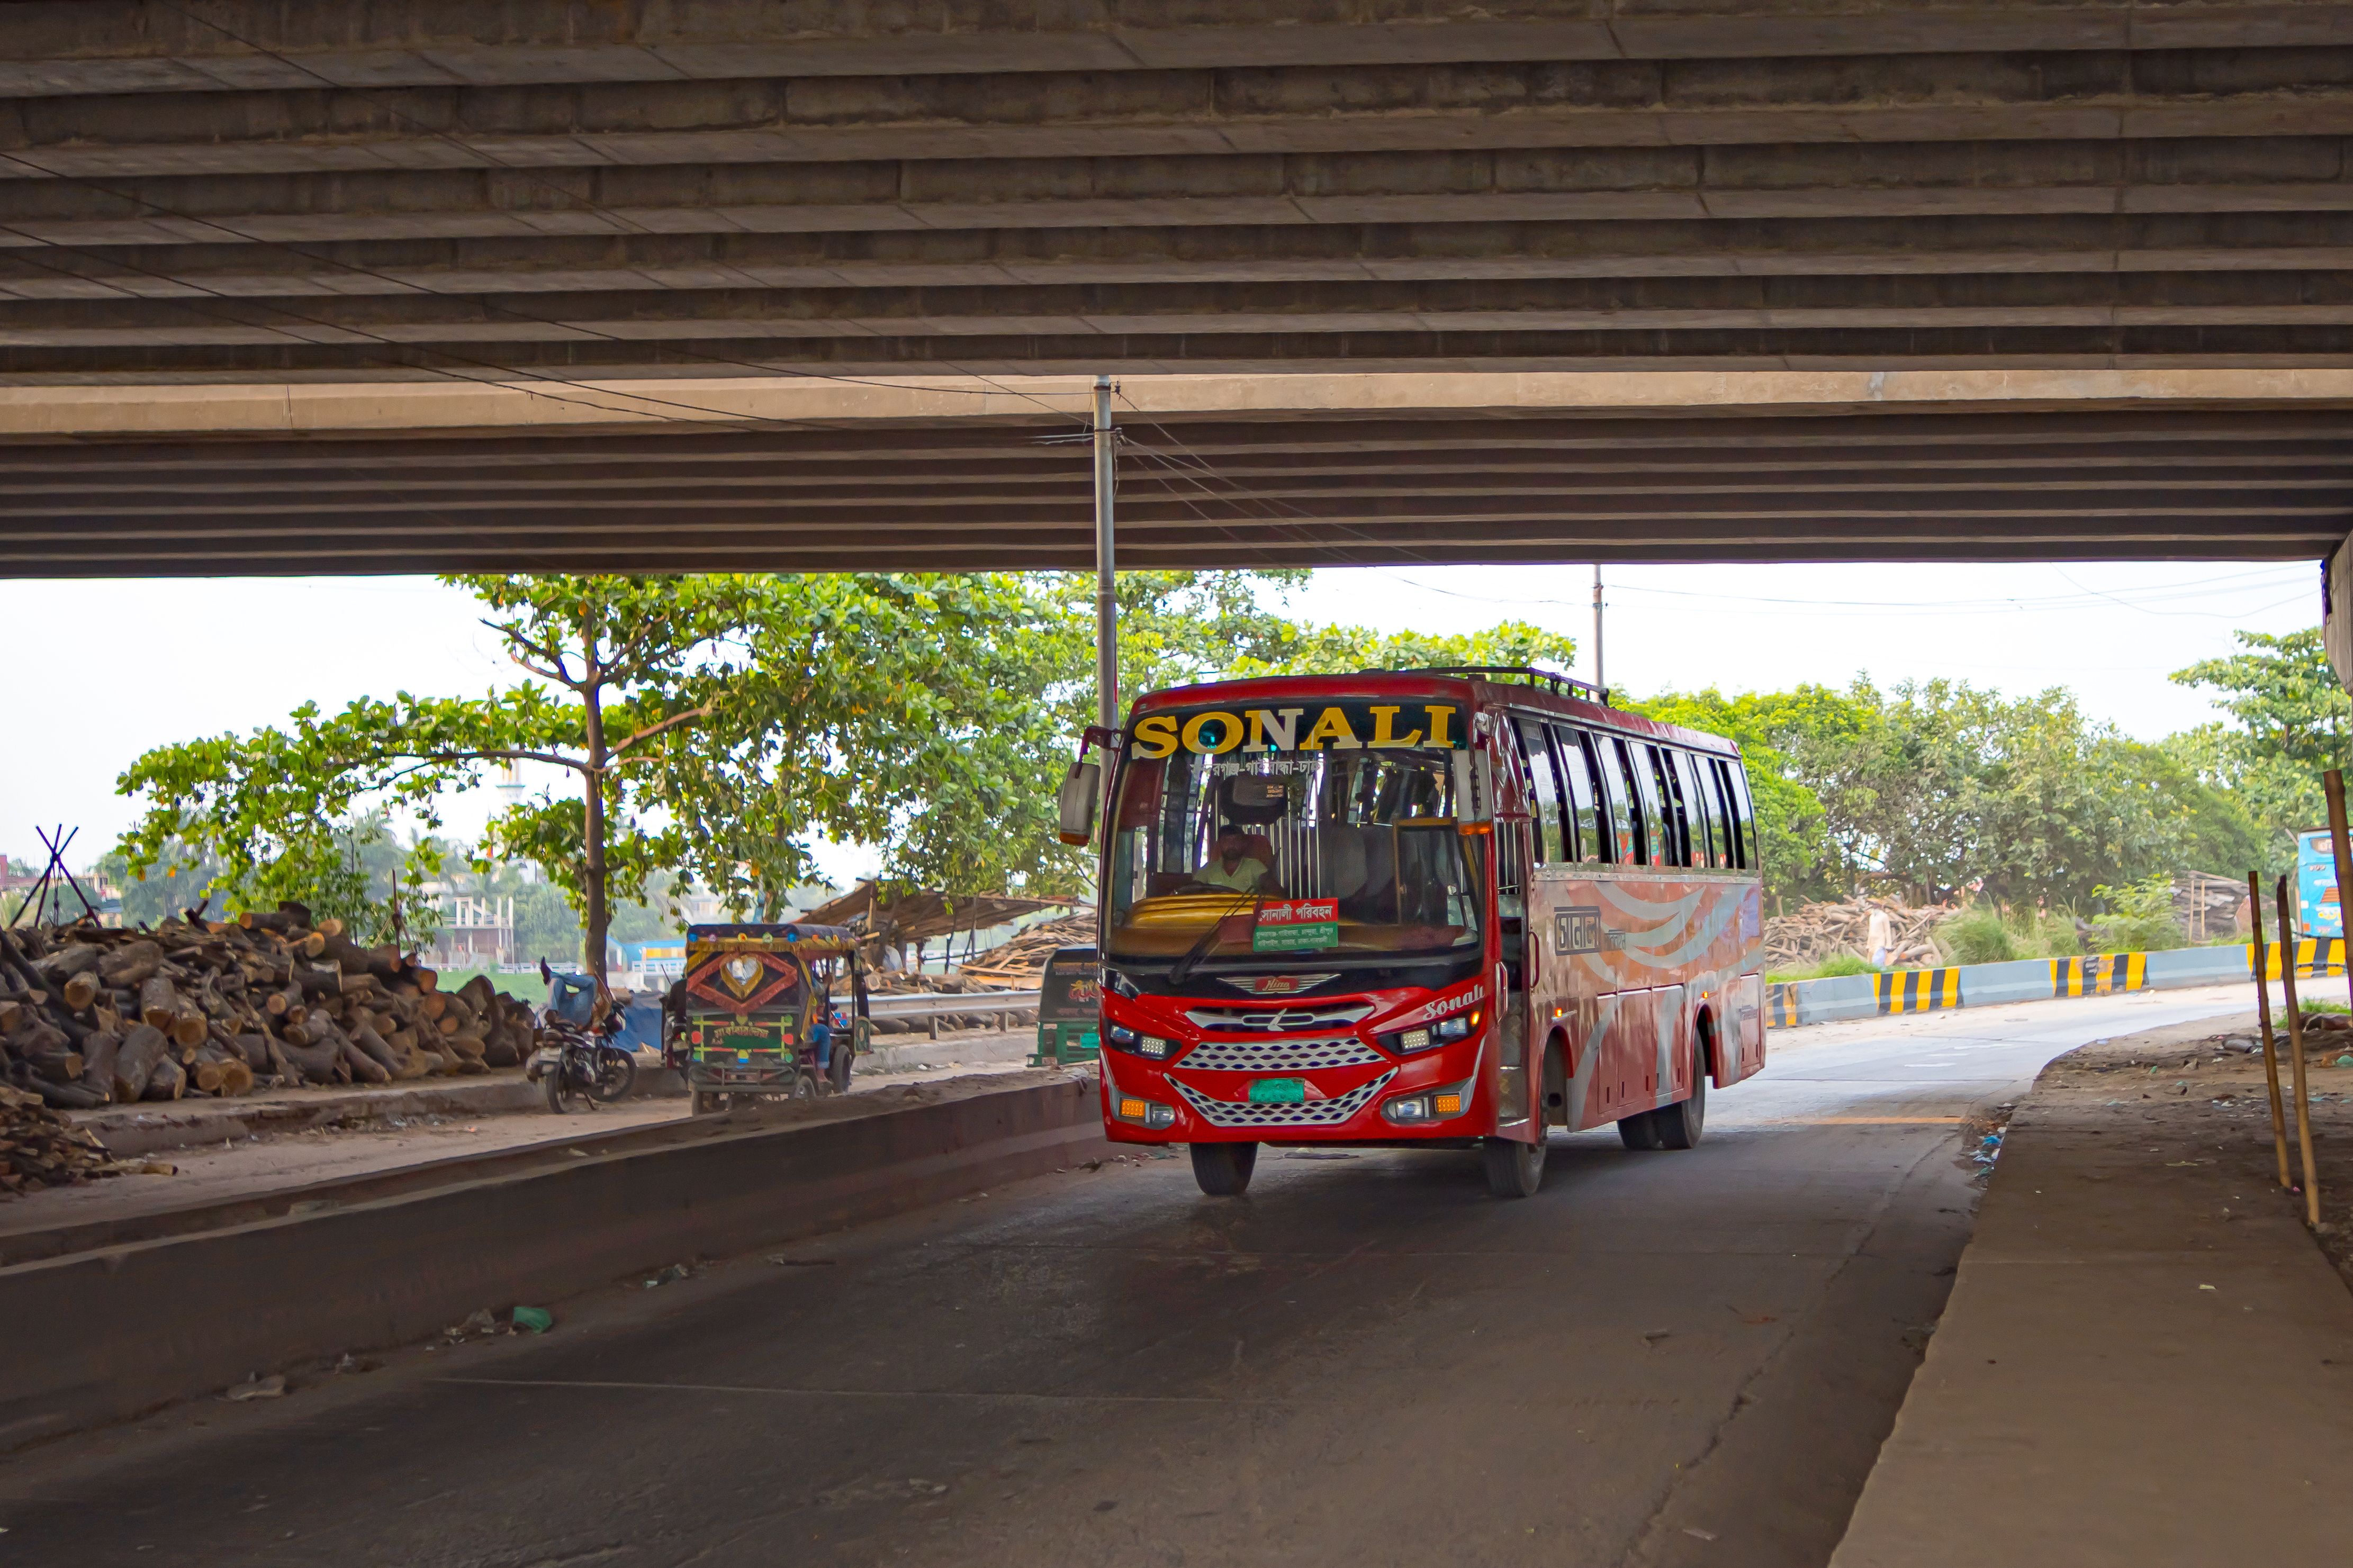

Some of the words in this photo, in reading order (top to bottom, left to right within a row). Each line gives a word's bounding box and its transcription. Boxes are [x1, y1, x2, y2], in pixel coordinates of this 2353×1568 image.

[1131, 705, 1456, 759] SONALI
[1296, 903, 1333, 919] পরিবহন
[1422, 984, 1485, 1020] Sonali
